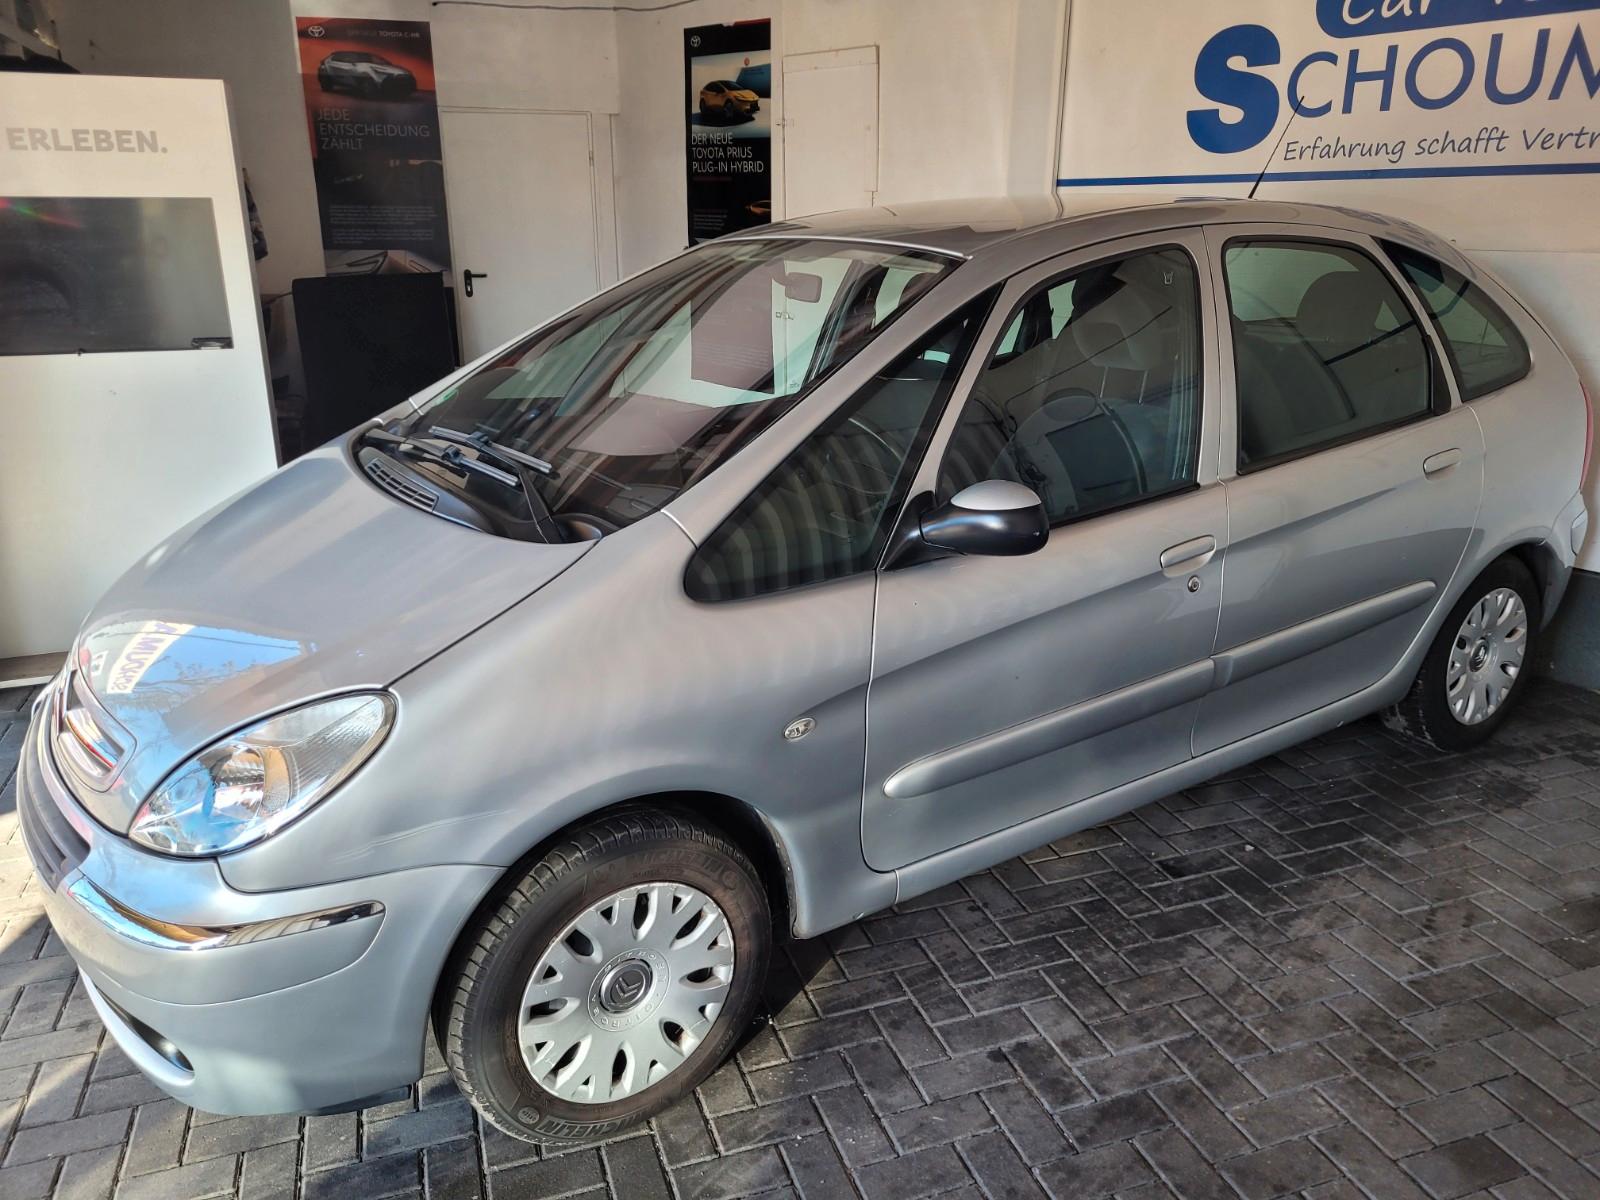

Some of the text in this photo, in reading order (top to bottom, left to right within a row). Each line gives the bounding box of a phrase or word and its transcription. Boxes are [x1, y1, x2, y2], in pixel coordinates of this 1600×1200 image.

[318, 108, 350, 121] JEDE
[319, 123, 431, 138] ENTSCHEIDUNG
[6, 127, 168, 153] ERLEBEN.
[691, 132, 733, 145] DER NEUE
[1284, 137, 1405, 163] Erfahrung
[1414, 127, 1509, 156] schafft
[692, 146, 753, 159] TOYOTA PRIUS
[692, 160, 764, 173] PLUG-IN HYBRID
